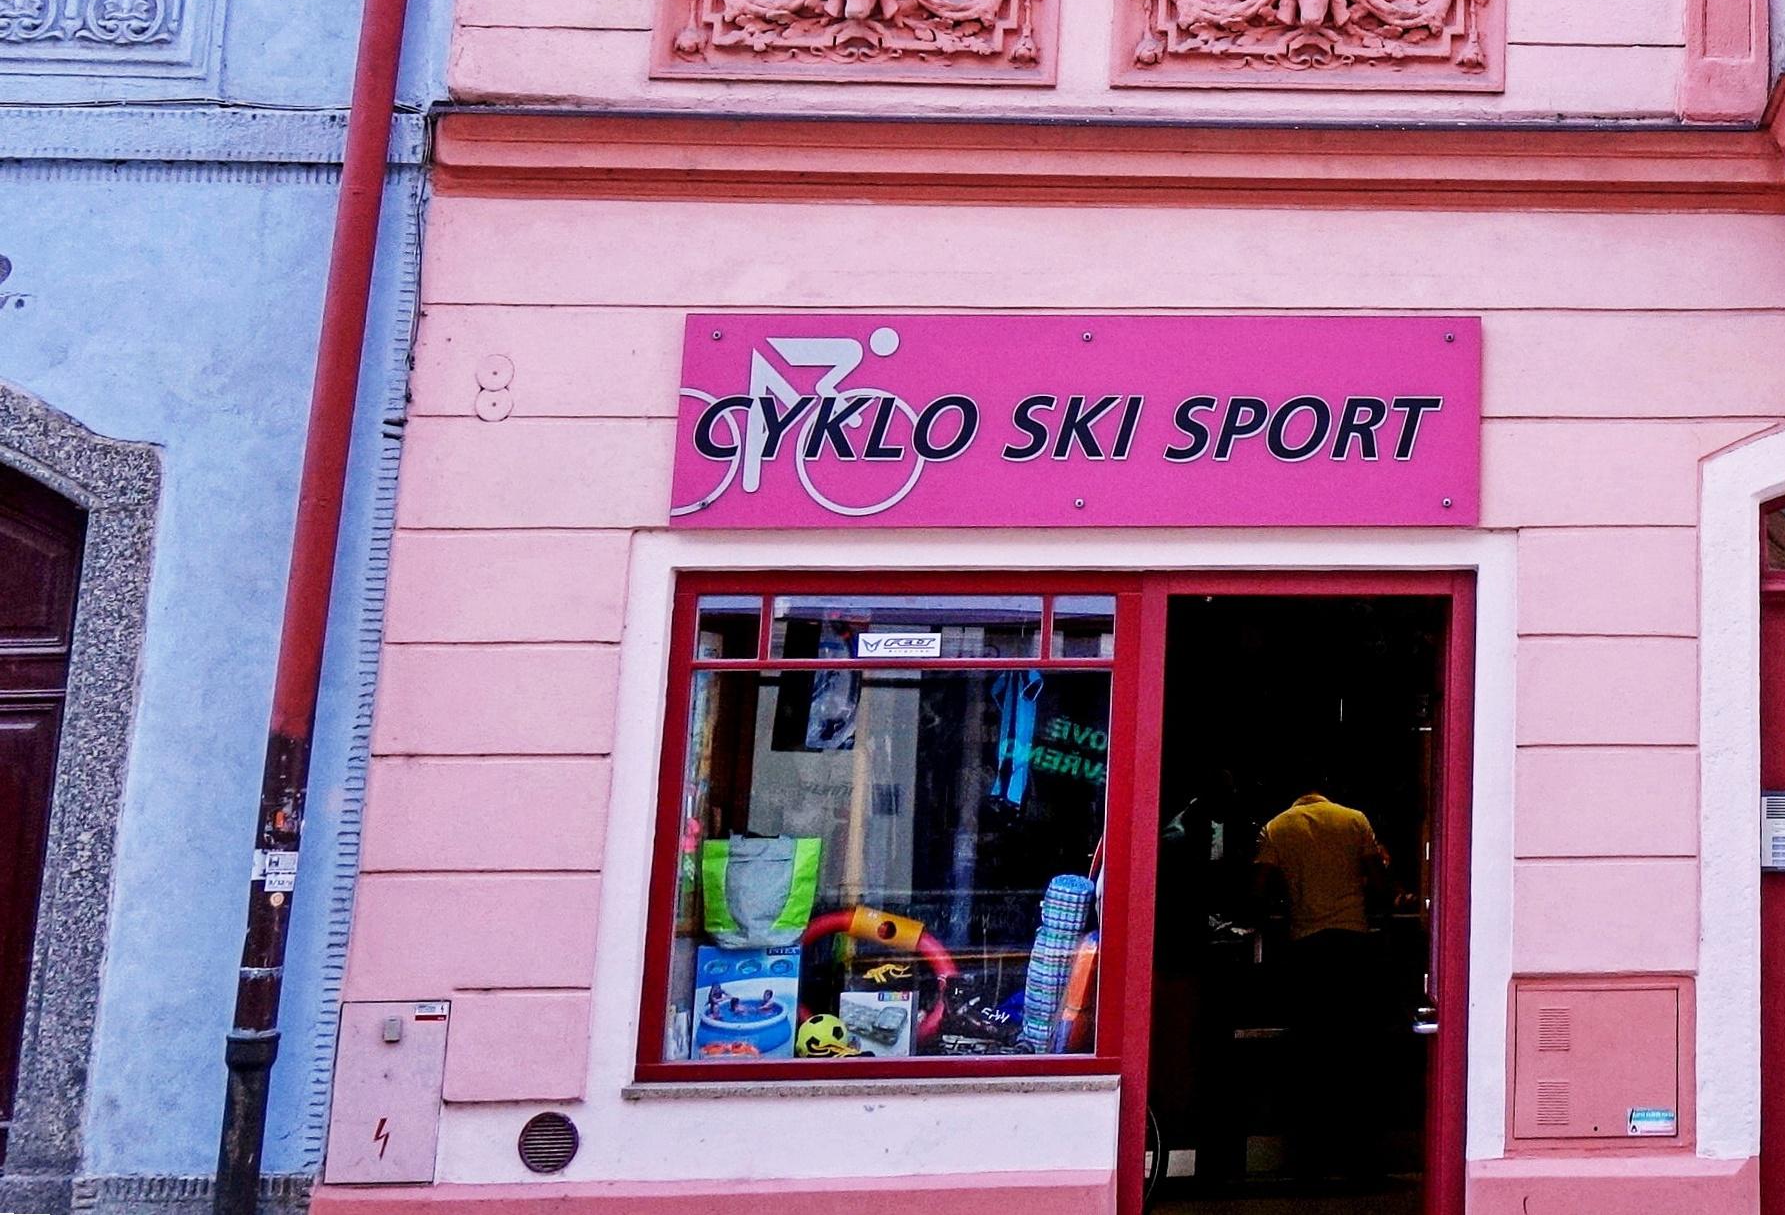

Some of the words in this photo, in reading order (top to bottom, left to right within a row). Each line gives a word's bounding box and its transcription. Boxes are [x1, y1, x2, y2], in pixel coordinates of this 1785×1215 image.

[694, 395, 980, 463] CYKLO
[1001, 395, 1144, 462] SKI
[1163, 395, 1443, 463] SPORT
